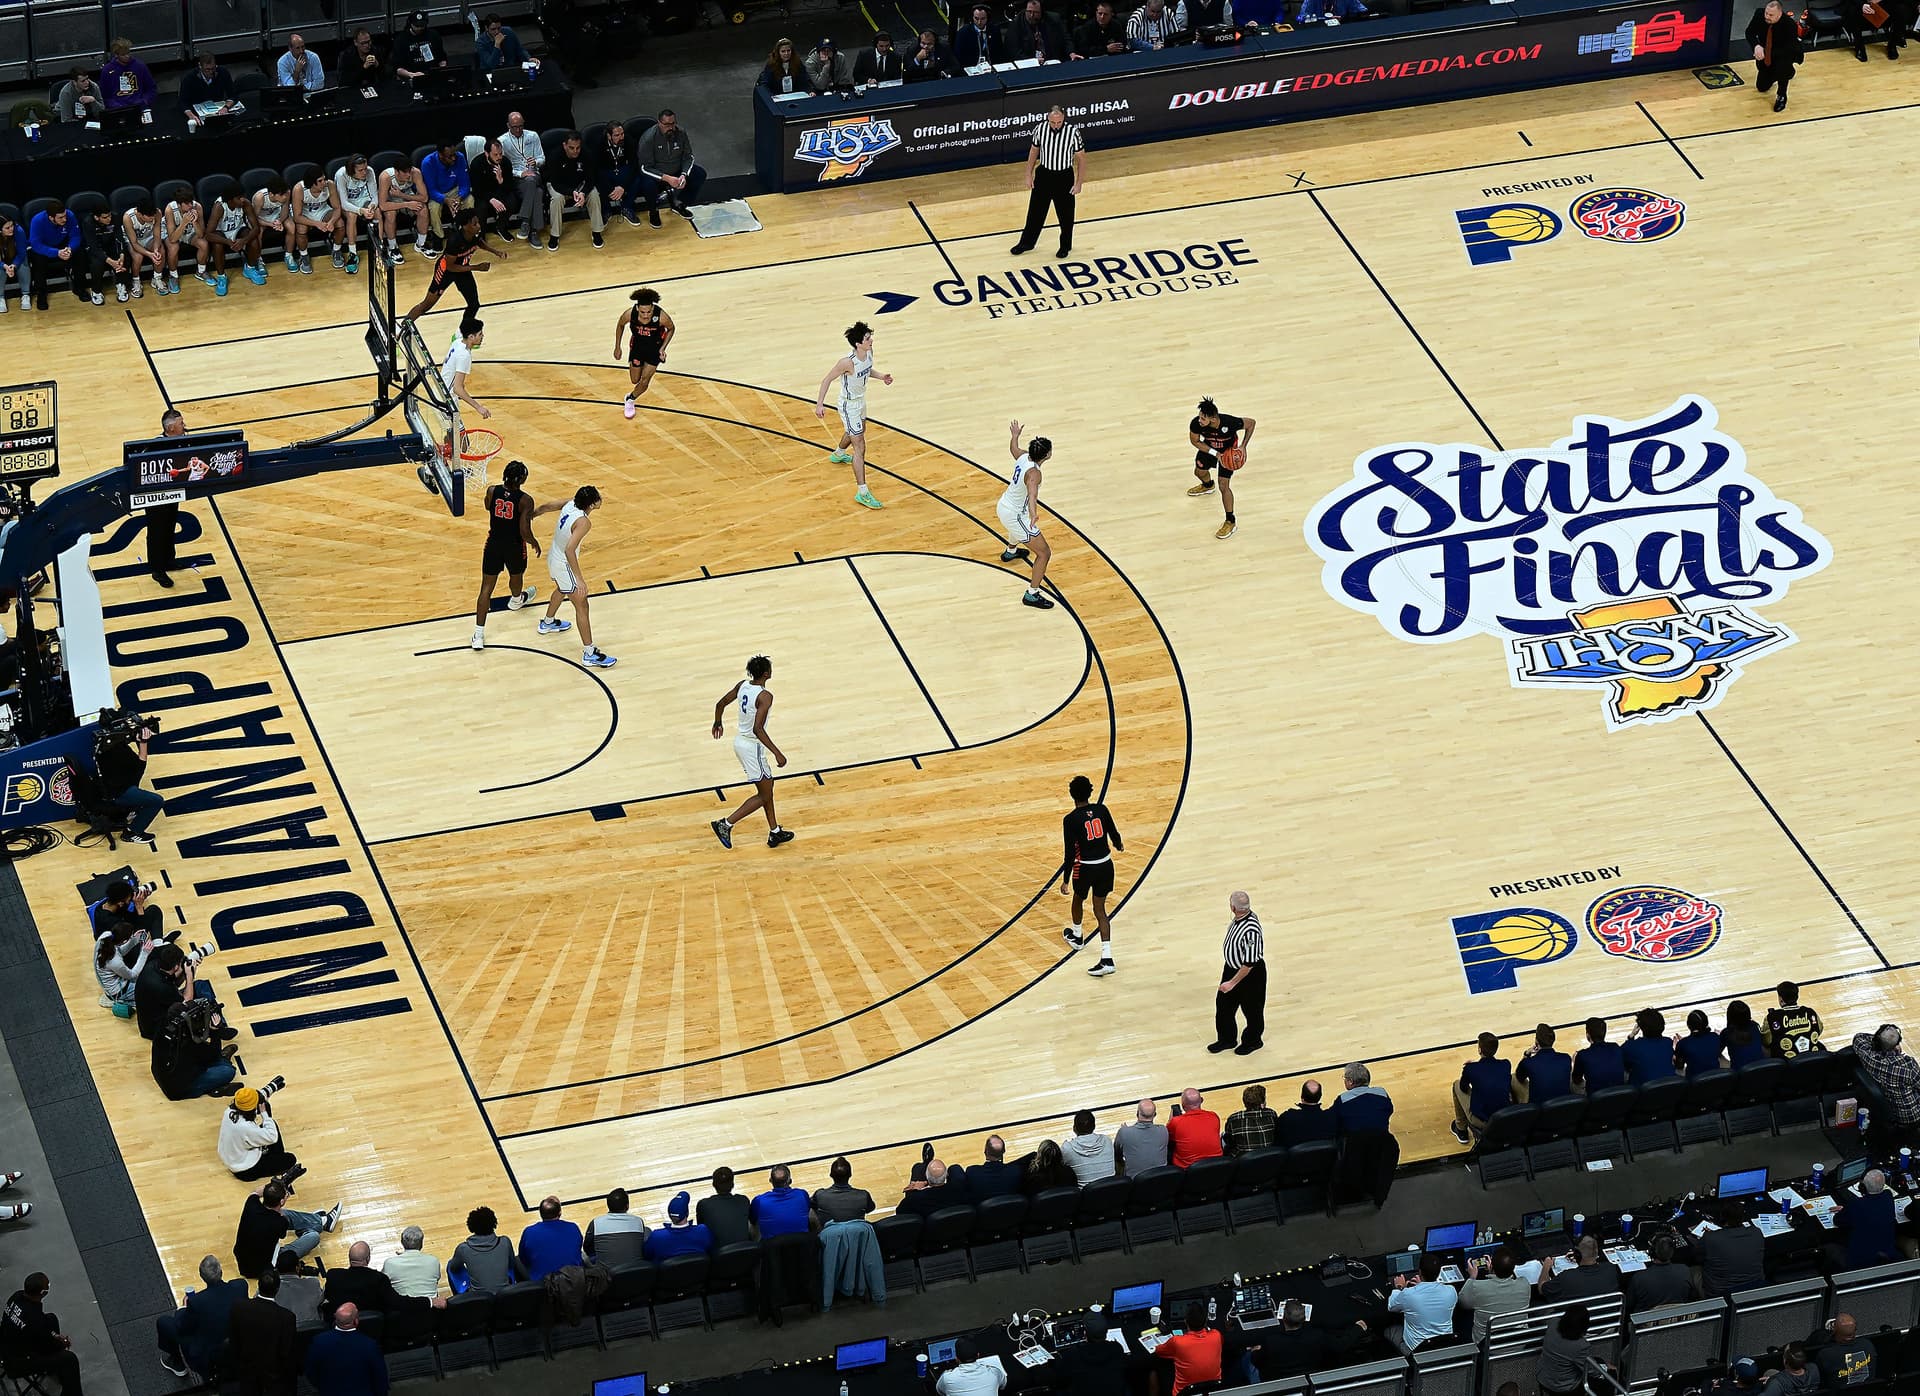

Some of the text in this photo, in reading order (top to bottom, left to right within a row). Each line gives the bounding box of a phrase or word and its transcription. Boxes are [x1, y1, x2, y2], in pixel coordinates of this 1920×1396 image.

[1168, 44, 1544, 109] DOUBLEEDGEMEDIA.COM
[913, 123, 960, 139] Official
[963, 112, 1049, 132] Photographer
[1067, 104, 1088, 117] the
[1090, 99, 1129, 114] IHSAA
[797, 121, 898, 159] IHSAA
[905, 145, 915, 153] To
[917, 142, 938, 152] order
[940, 135, 990, 150] photographs
[992, 132, 1011, 142] from
[1481, 173, 1596, 198] PRESENTED BY
[1581, 191, 1651, 212] INDIANA
[1581, 197, 1682, 237] Fever
[933, 239, 1259, 307] GAINBRIDGE
[984, 271, 1240, 319] FIELDHOUSE
[13, 436, 54, 448] TISSOT
[141, 458, 174, 475] BOYS
[1317, 401, 1729, 551] State
[147, 492, 182, 503] Wilson
[495, 499, 514, 520] 23
[559, 513, 570, 530] 4
[1341, 484, 1818, 636] Finals
[1518, 613, 1778, 675] IHSAA
[742, 694, 749, 714] 2
[22, 757, 57, 769] PRESENTED
[1084, 818, 1104, 840] 10
[1489, 866, 1623, 898] PRESENTED BY
[1601, 891, 1682, 918] INDIANA
[1600, 899, 1719, 954] Fever
